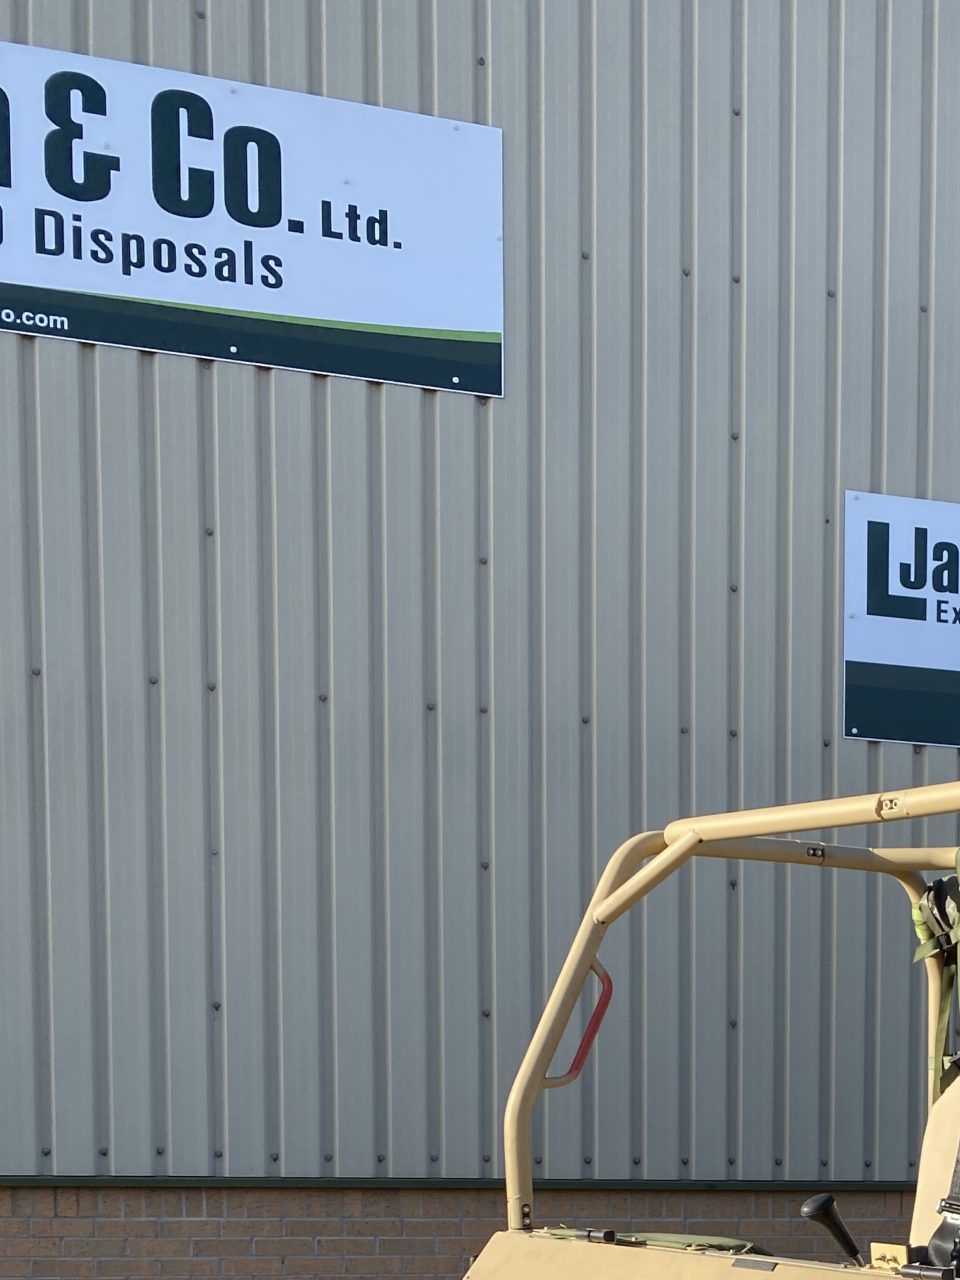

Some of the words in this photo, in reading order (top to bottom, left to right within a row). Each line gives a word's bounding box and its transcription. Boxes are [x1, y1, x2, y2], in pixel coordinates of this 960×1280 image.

[44, 70, 121, 202] &
[151, 89, 304, 234] Co.
[321, 200, 403, 250] Ltd.
[34, 207, 284, 290] Disposals
